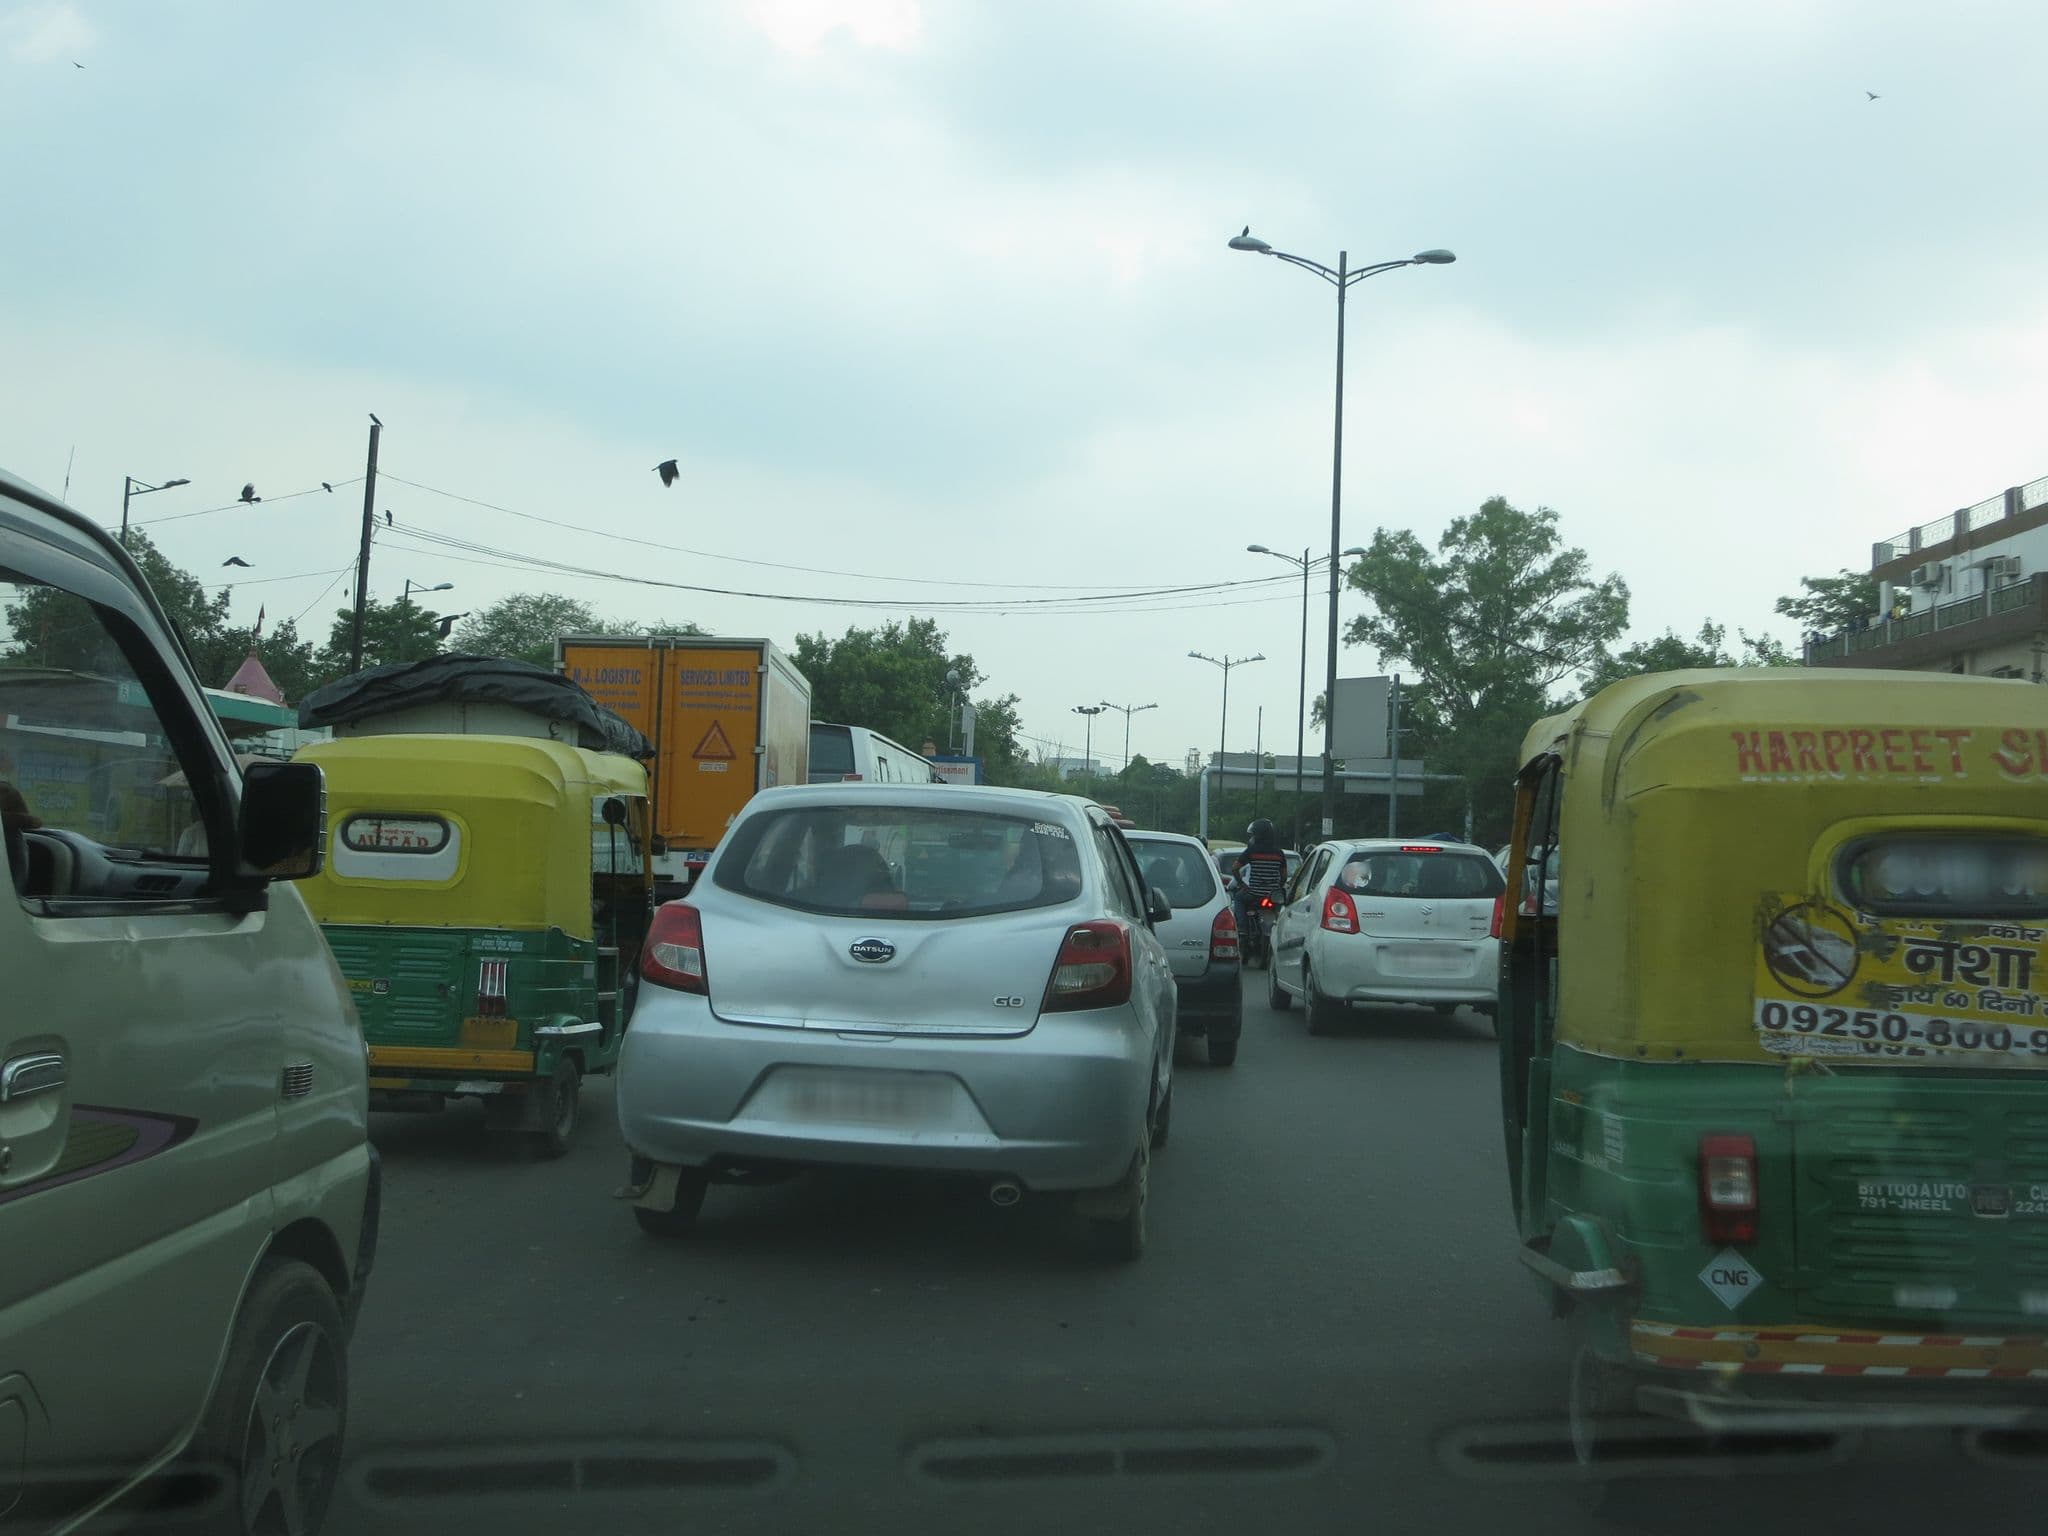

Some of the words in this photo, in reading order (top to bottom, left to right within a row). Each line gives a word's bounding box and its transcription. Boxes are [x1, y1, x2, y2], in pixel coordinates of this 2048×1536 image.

[596, 667, 641, 685] LOGISTIC
[719, 670, 750, 687] LIMITED
[1731, 729, 1971, 775] HARPREET
[853, 945, 892, 954] DATSUN
[1903, 936, 2038, 991] नशा
[993, 996, 1025, 1008] GO
[1943, 991, 1970, 1009] 60
[1978, 989, 2041, 1016] दिनों
[1858, 1197, 1952, 1211] 791-JHEEL
[1711, 1268, 1749, 1286] CNG
